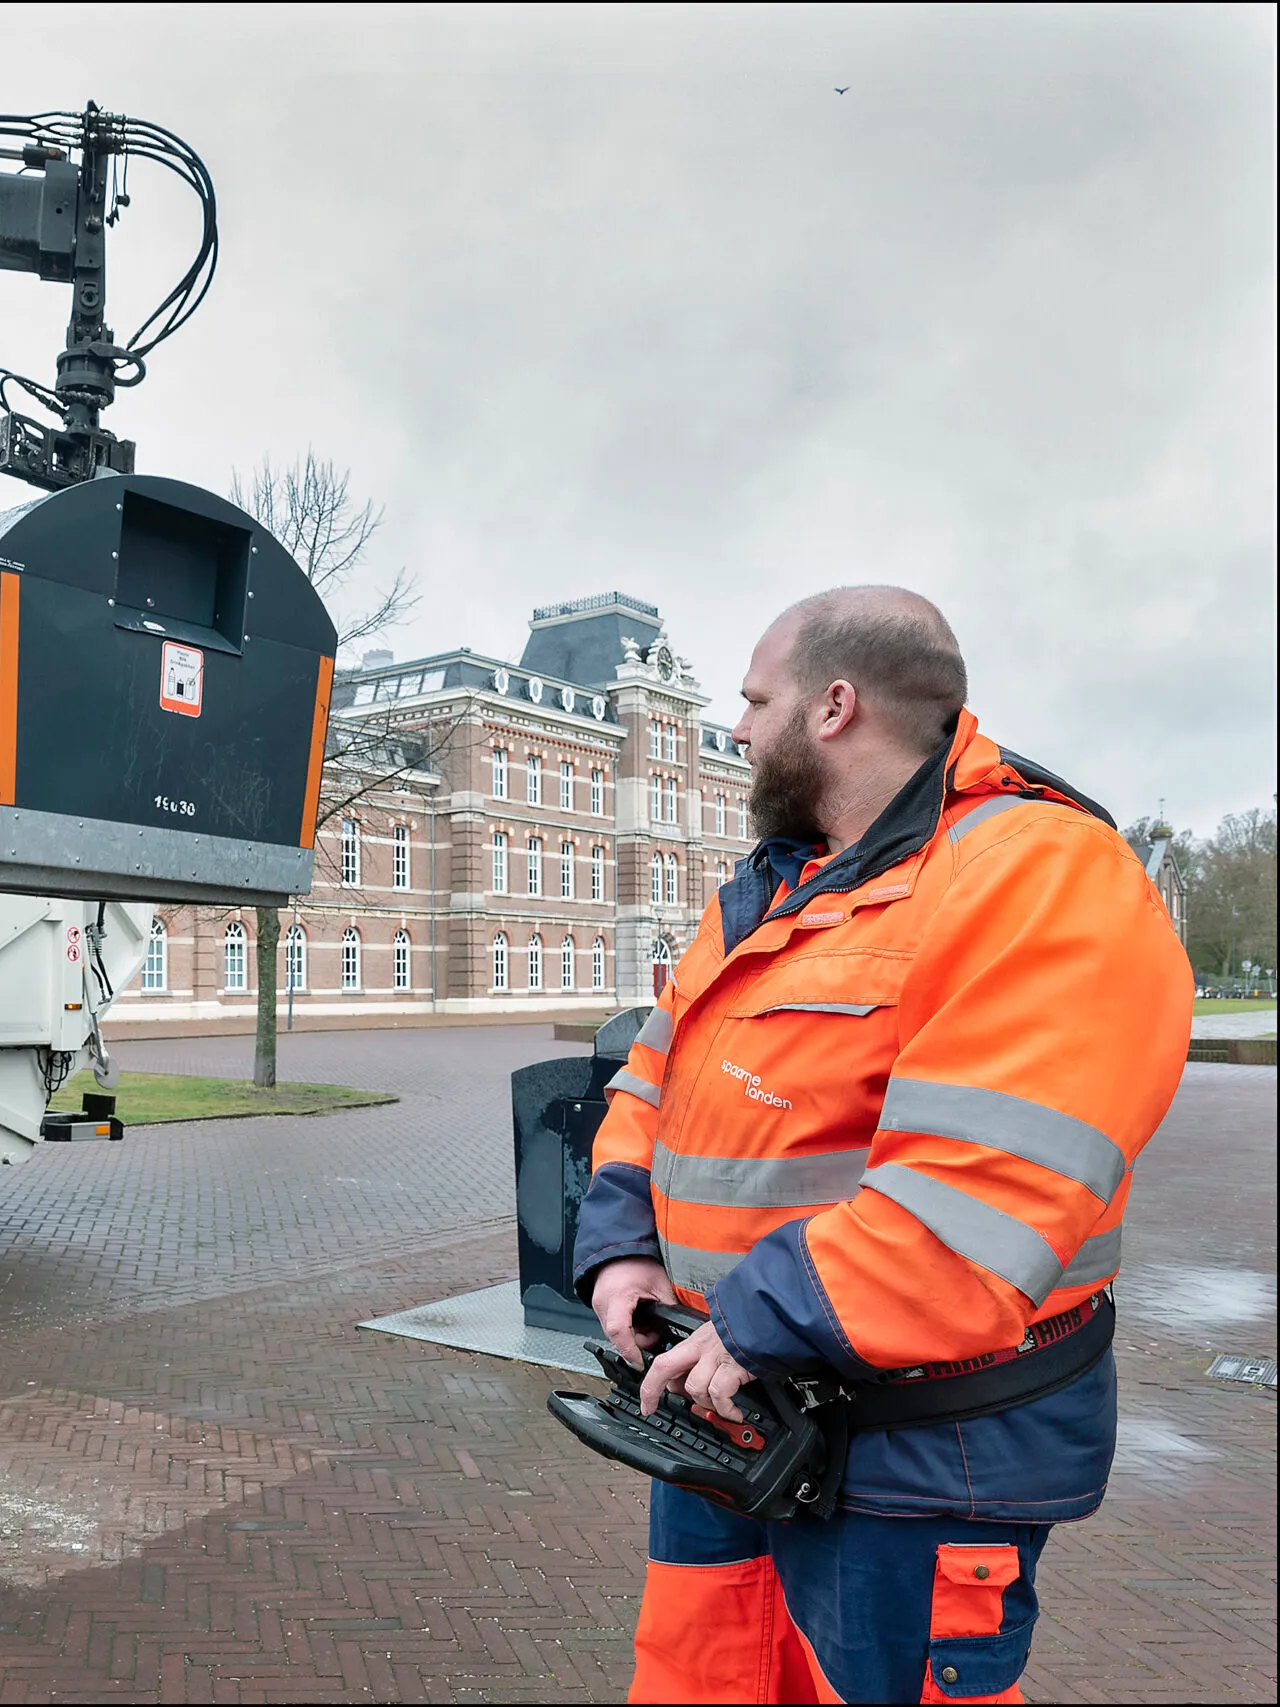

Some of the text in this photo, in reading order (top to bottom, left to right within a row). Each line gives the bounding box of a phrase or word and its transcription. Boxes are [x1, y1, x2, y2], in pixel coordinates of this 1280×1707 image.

[721, 1059, 762, 1087] spaarne
[745, 1082, 793, 1111] landen
[1036, 1307, 1083, 1345] HIAB
